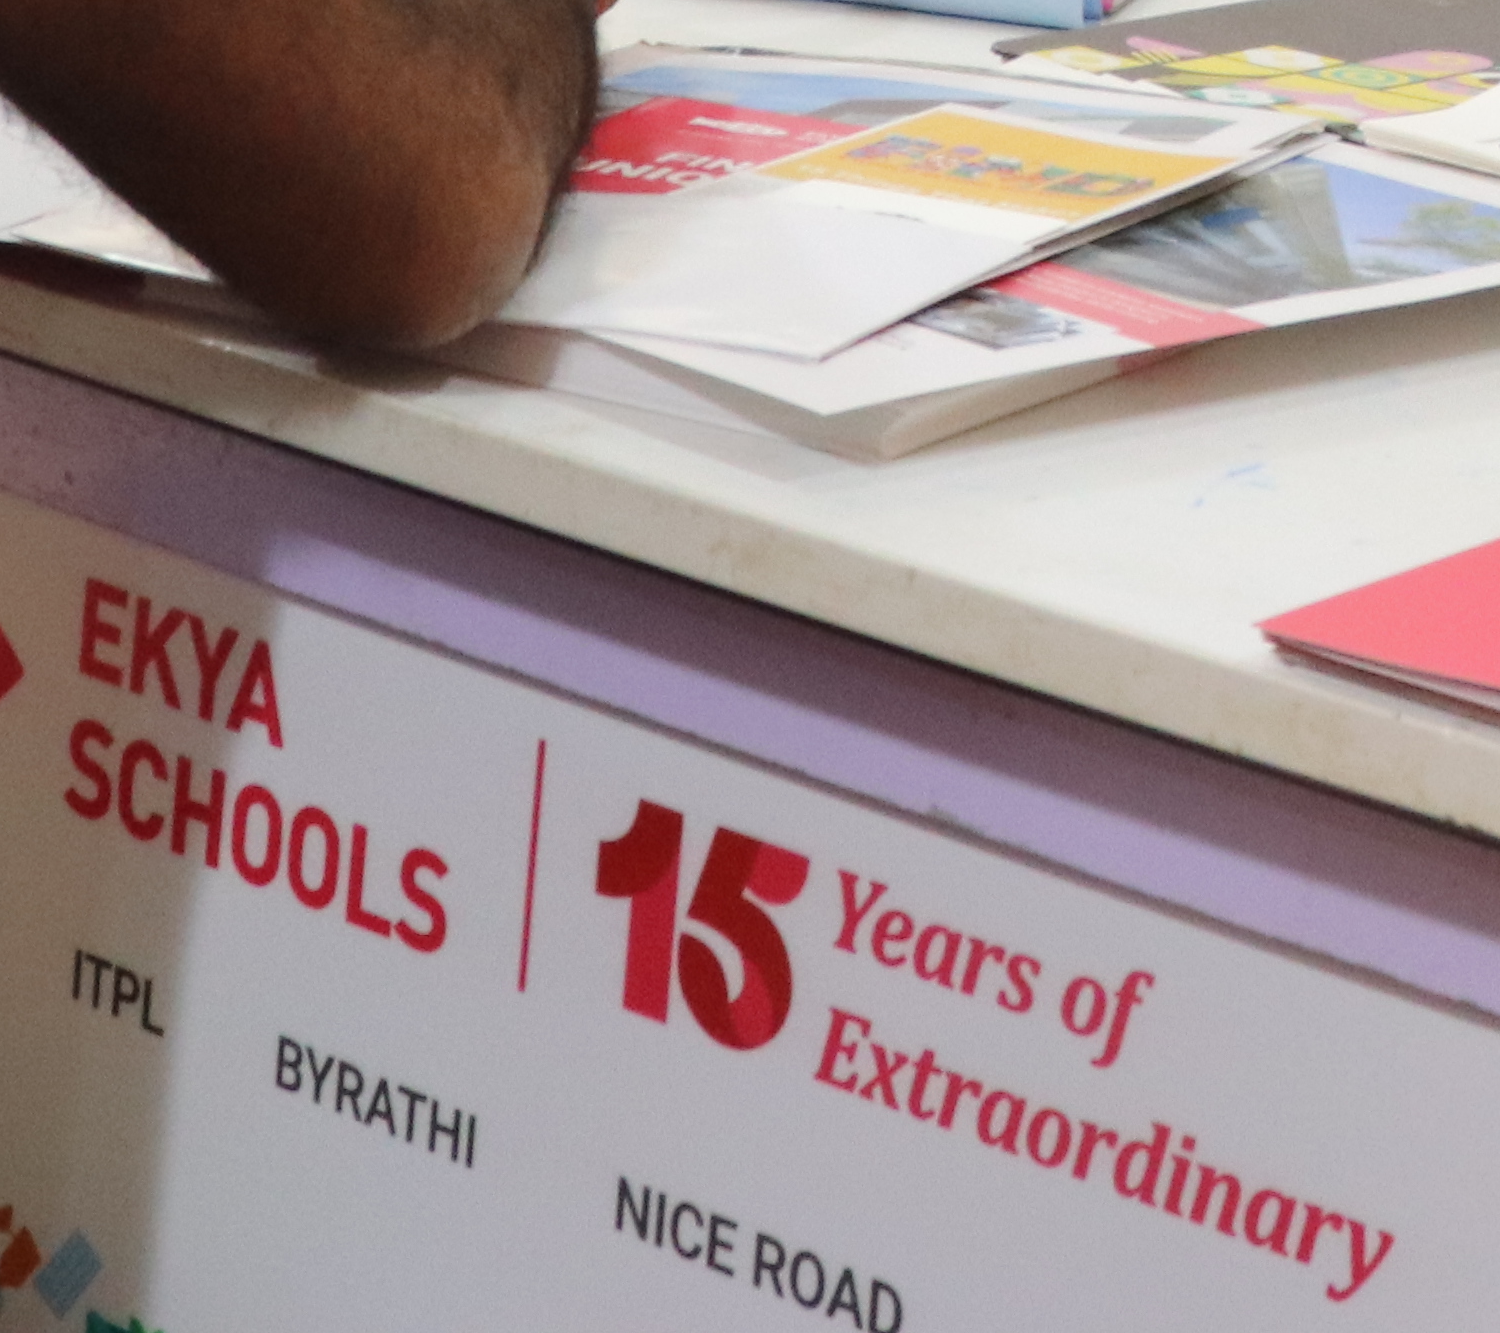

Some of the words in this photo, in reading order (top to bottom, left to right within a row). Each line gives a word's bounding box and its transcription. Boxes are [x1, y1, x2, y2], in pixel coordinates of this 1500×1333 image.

[71, 580, 283, 756] EKYA
[66, 709, 448, 953] SCHOOLS
[590, 794, 814, 1053] 15
[72, 948, 163, 1036] ITPL
[831, 871, 1041, 1024] Years
[1062, 972, 1154, 1068] of
[276, 1035, 476, 1168] BYRATHI
[815, 997, 1395, 1302] Extraordinary
[616, 1177, 737, 1276] NICE
[753, 1233, 902, 1333] ROAD
